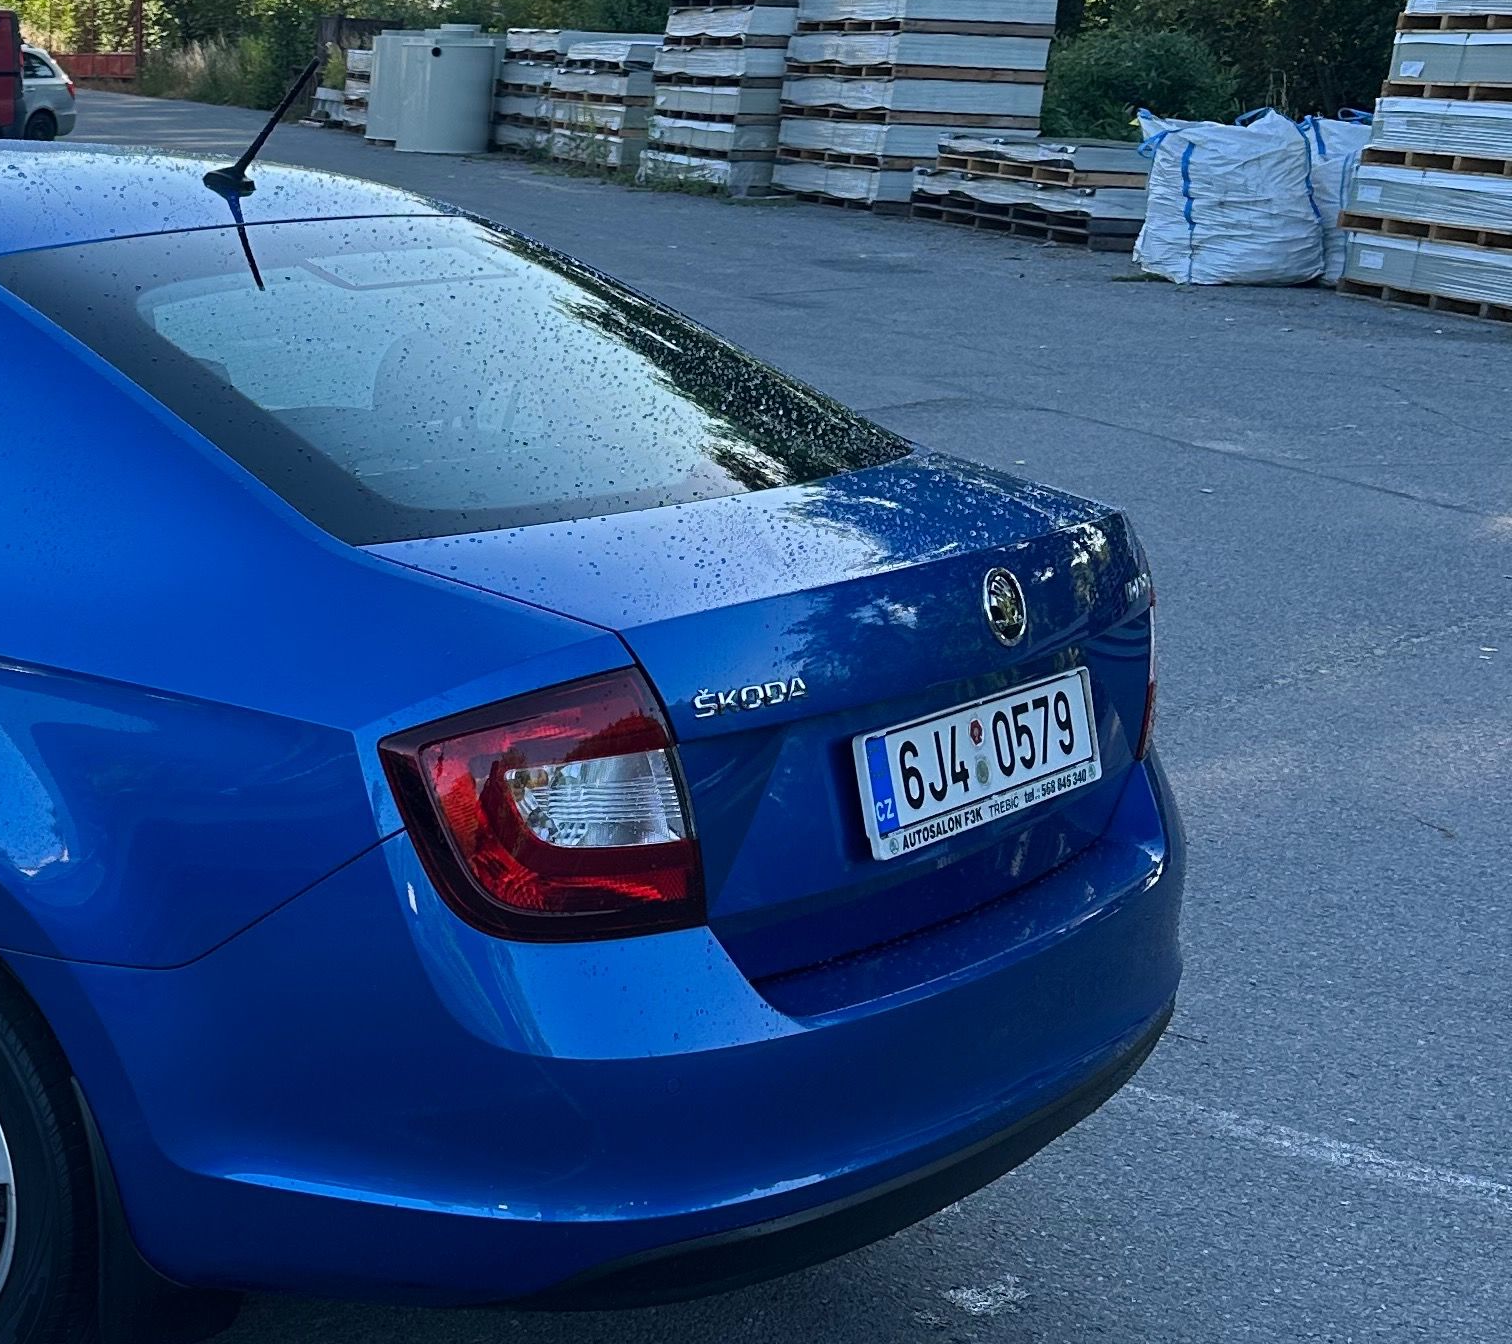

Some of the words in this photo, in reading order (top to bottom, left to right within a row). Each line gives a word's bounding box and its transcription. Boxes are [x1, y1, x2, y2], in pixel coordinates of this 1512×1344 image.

[693, 676, 807, 719] ŠKODA
[898, 724, 971, 811] 6J4
[992, 690, 1075, 777] 0579
[875, 798, 895, 822] CZ
[901, 813, 963, 851] AUTOSALON
